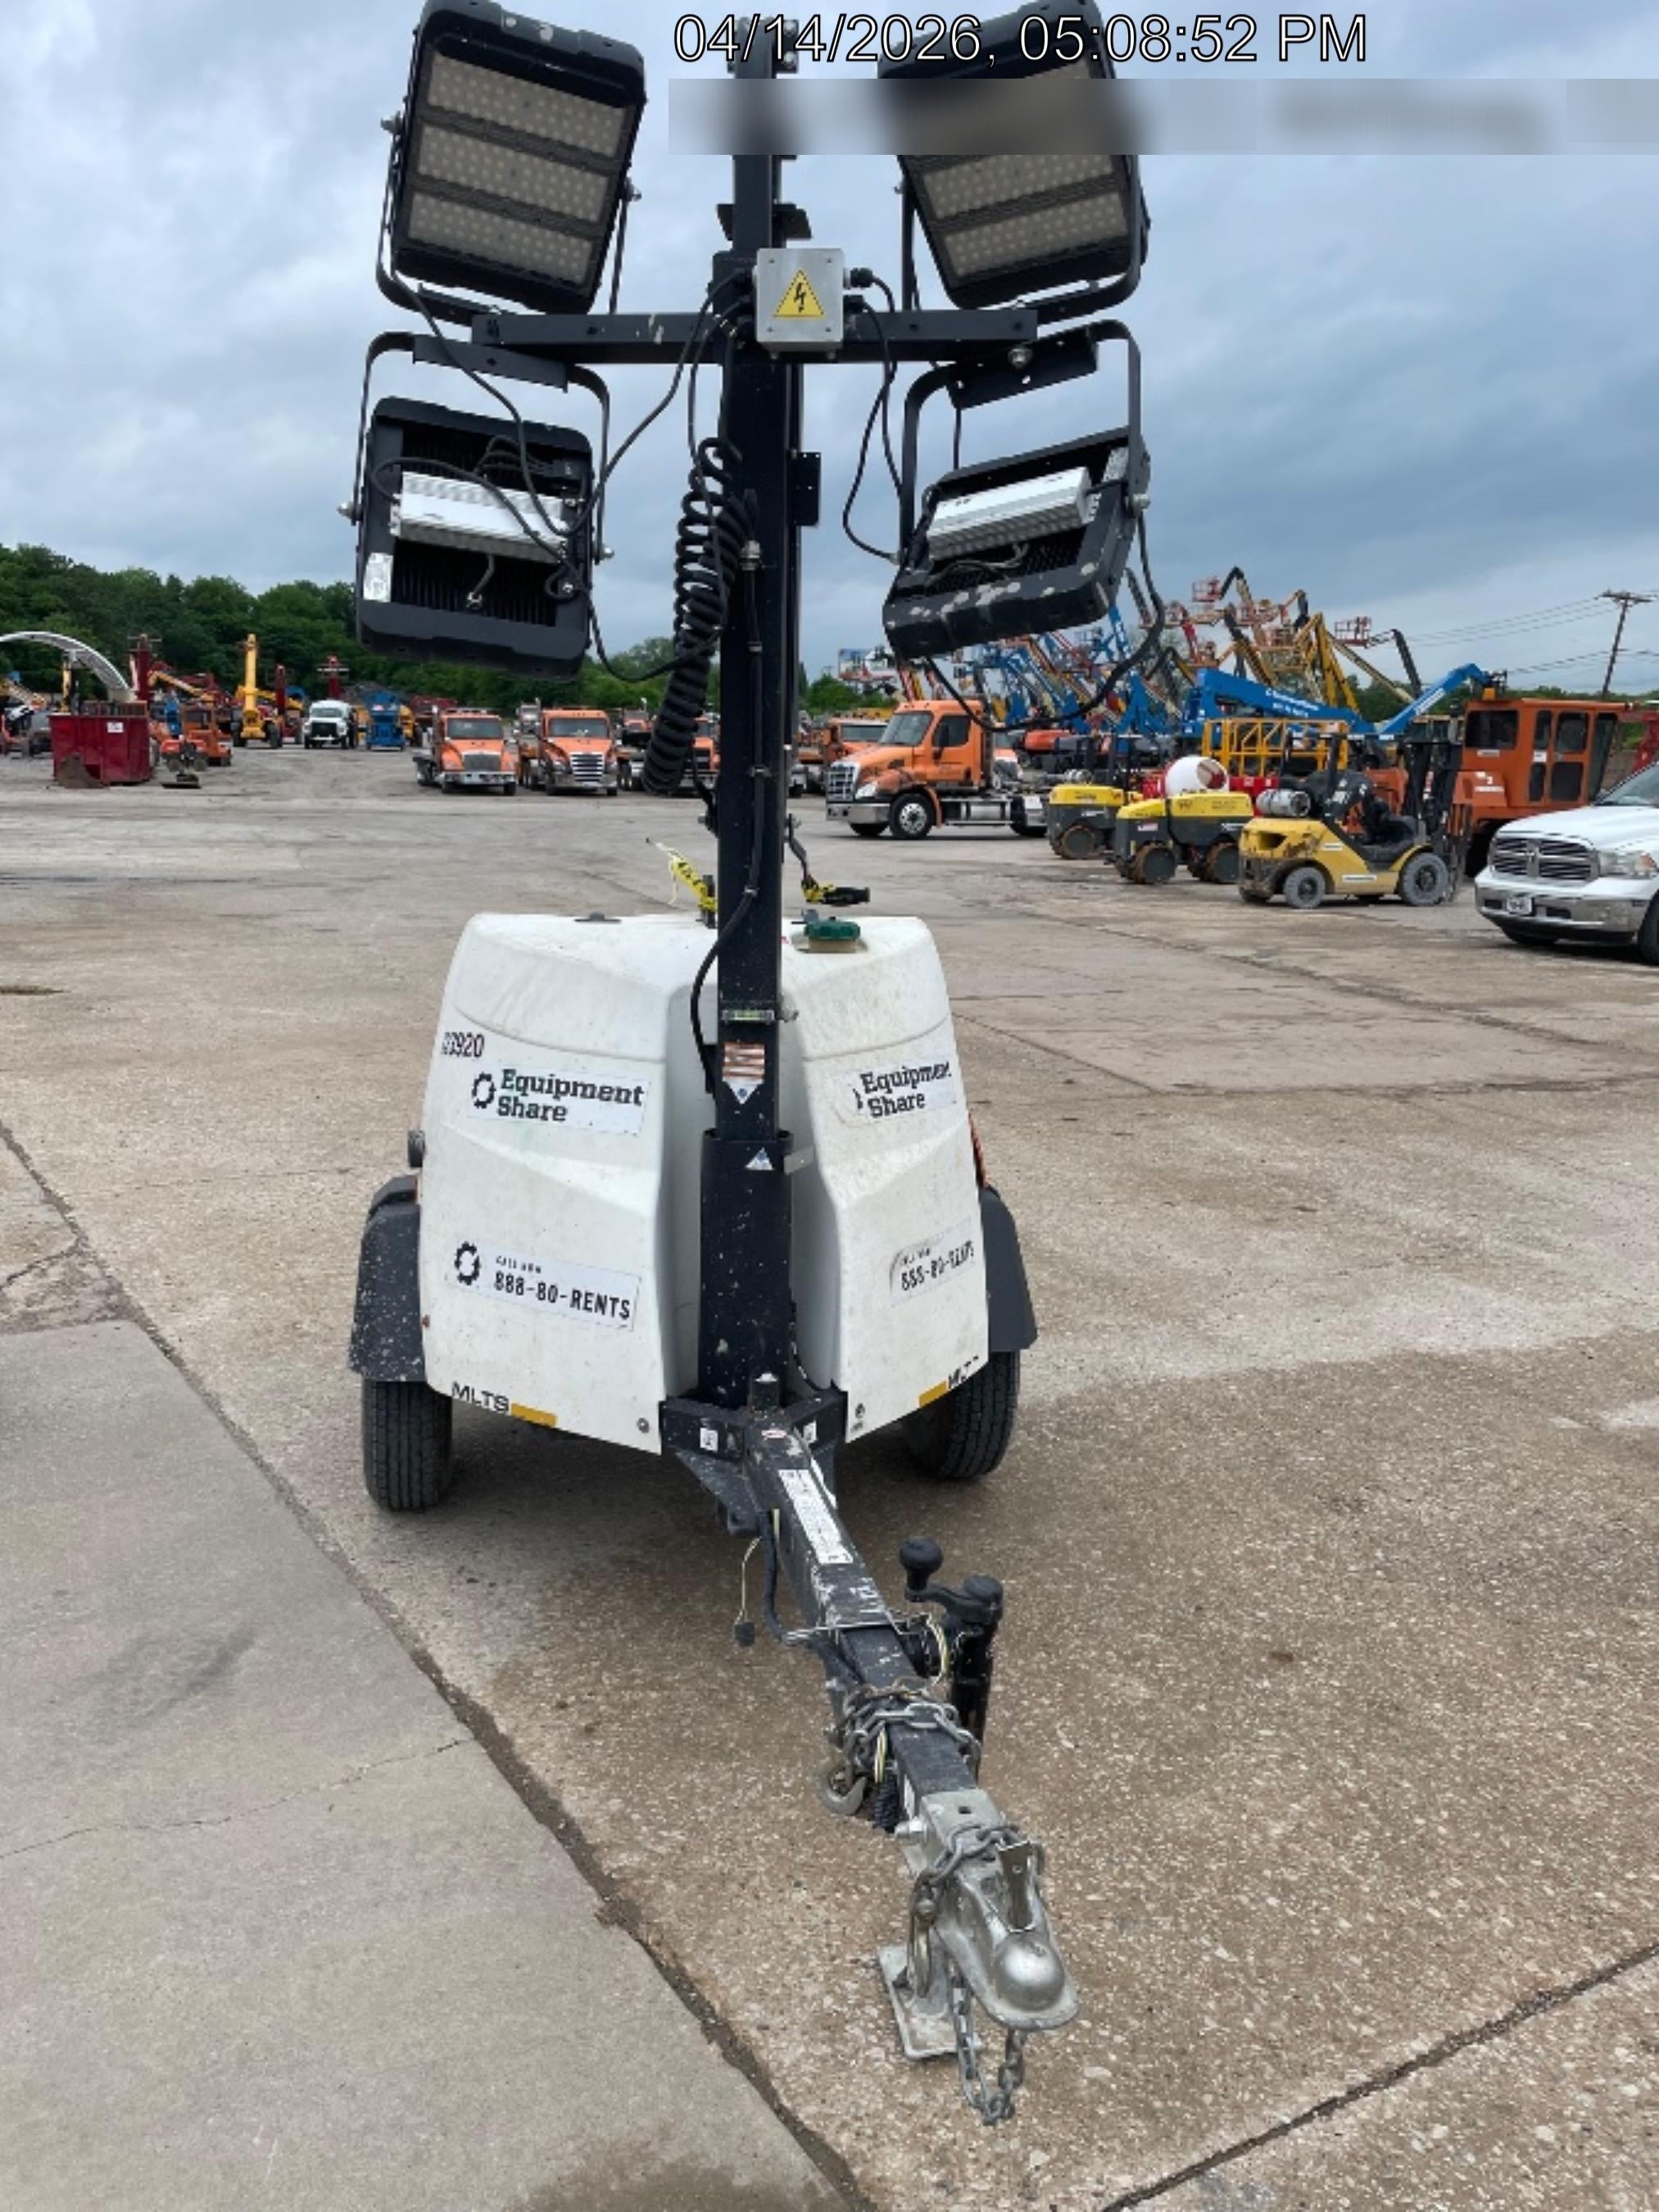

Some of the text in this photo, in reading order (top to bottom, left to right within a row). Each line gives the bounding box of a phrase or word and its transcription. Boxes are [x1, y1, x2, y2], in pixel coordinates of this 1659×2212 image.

[501, 1068, 645, 1106] Equipment
[497, 1095, 568, 1122] Share
[868, 1093, 925, 1118] Share
[494, 1271, 631, 1320] 888-80-RENTS
